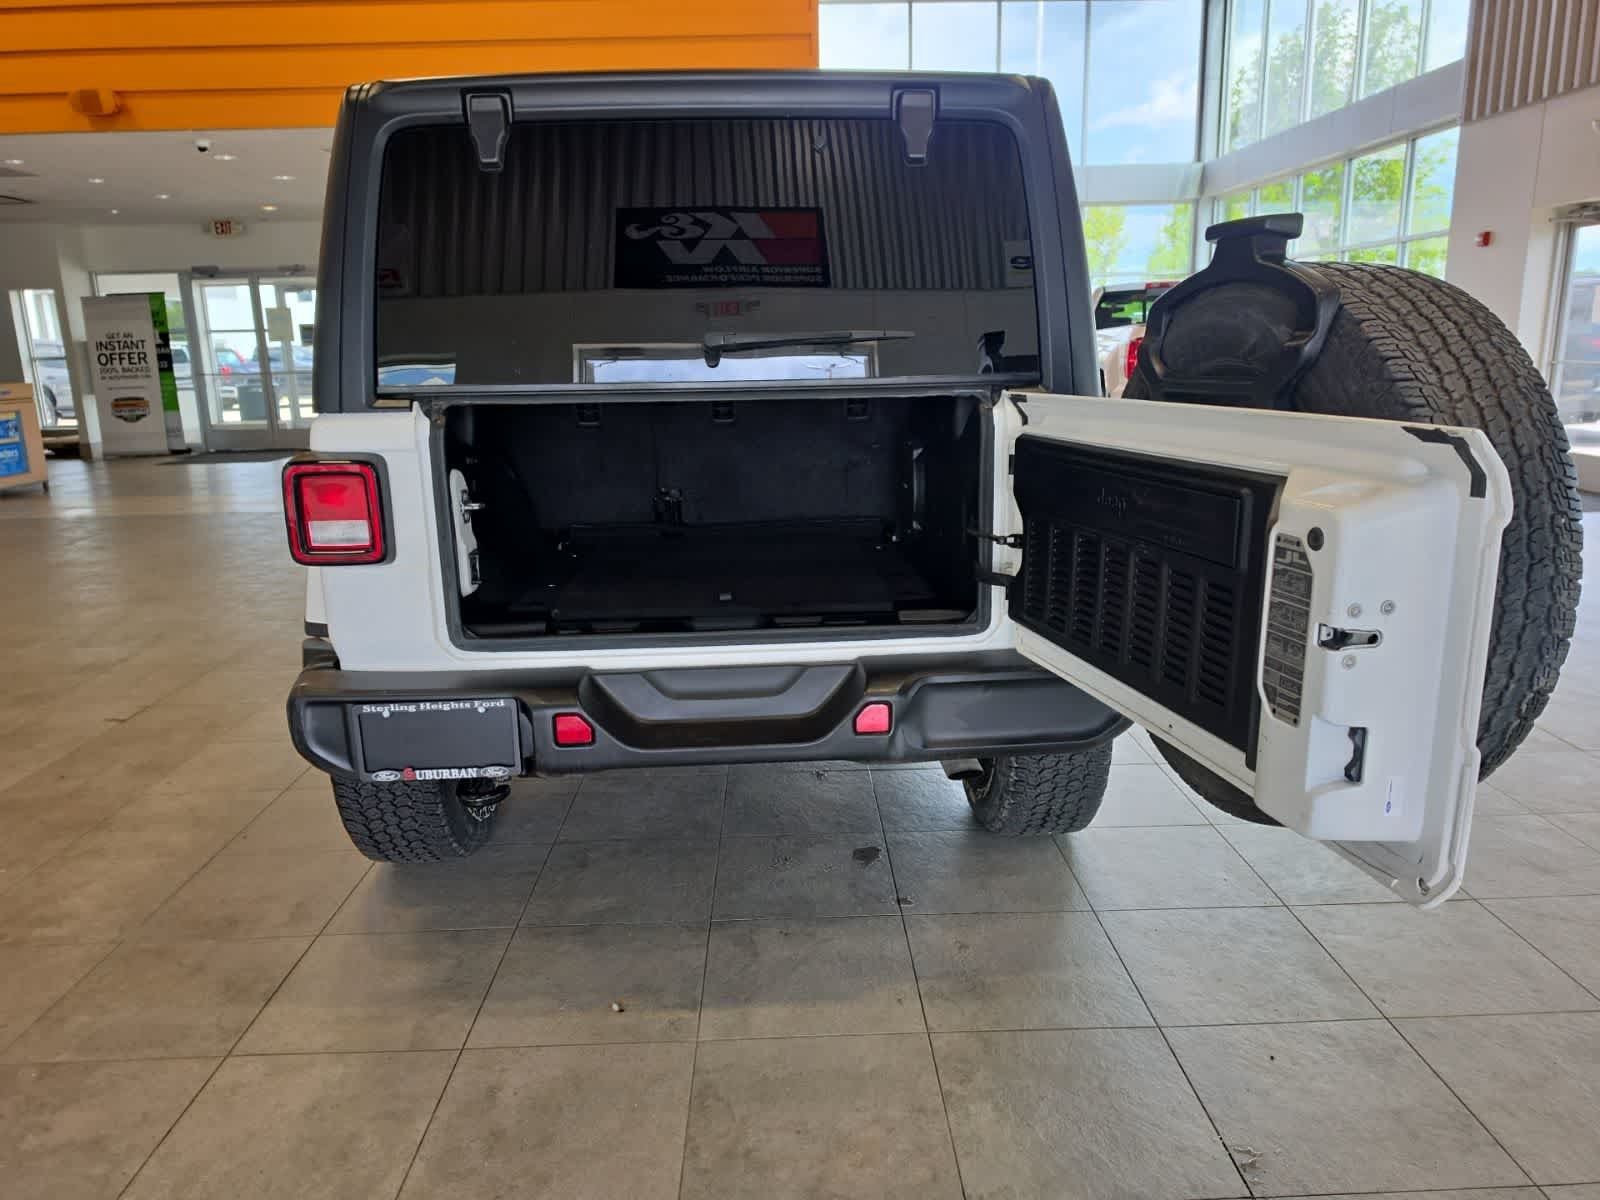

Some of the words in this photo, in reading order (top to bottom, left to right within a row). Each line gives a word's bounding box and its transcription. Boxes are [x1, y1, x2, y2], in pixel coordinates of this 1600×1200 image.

[214, 221, 232, 235] EXIT
[95, 339, 146, 351] INSTANT
[97, 352, 148, 366] OFFER
[362, 703, 417, 713] Sterling
[419, 701, 471, 711] Heights
[474, 699, 505, 709] Ford
[402, 767, 478, 781] SUBURBAN
